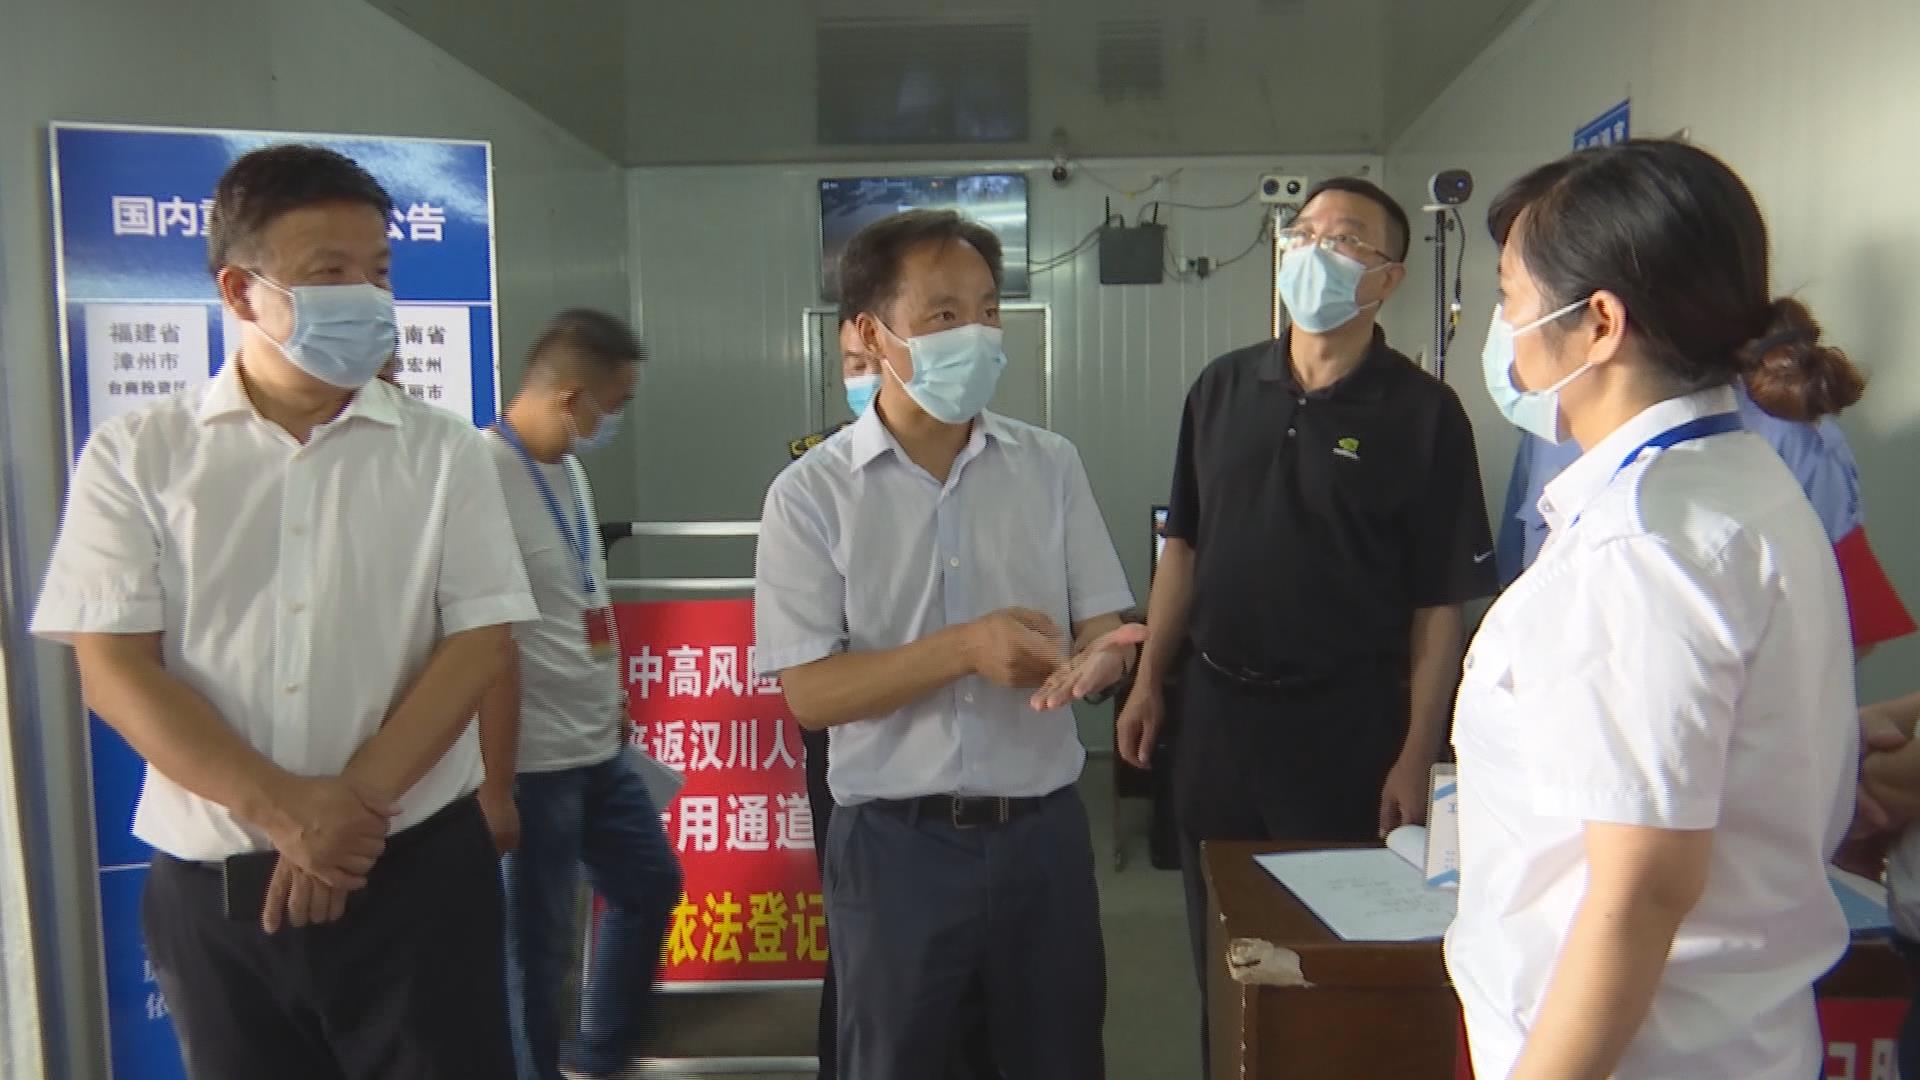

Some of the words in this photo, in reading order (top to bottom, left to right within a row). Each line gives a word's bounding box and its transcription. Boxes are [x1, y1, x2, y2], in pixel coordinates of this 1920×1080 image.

[111, 195, 216, 236] 国内
[109, 322, 181, 343] 福建省
[394, 325, 447, 345] 南省
[112, 352, 179, 371] 漳州市
[630, 719, 808, 772] 返汉川人
[657, 793, 817, 853] 用通道
